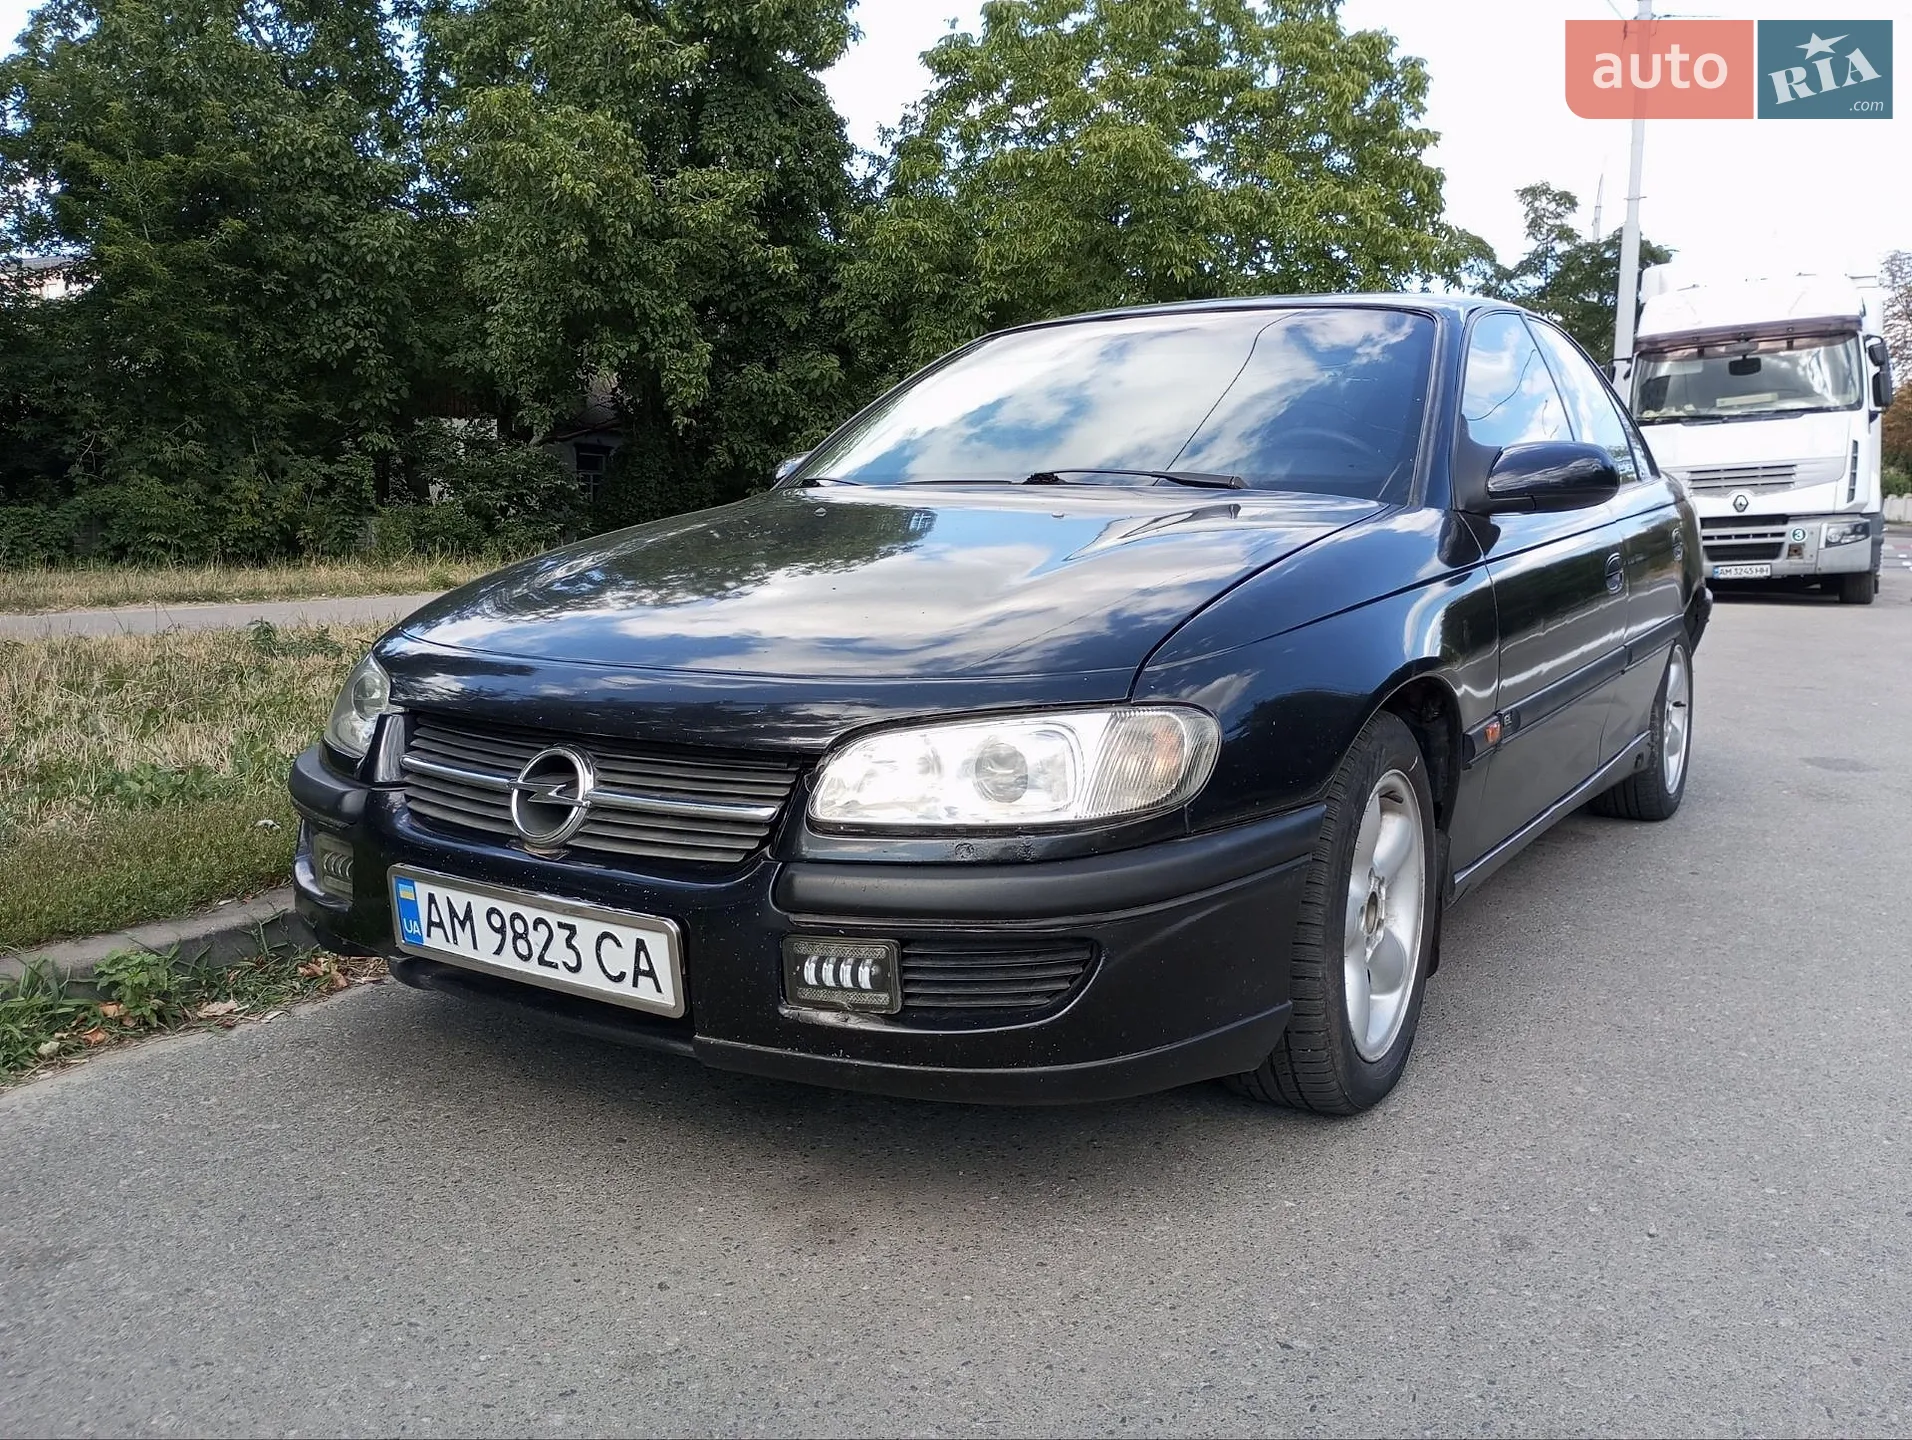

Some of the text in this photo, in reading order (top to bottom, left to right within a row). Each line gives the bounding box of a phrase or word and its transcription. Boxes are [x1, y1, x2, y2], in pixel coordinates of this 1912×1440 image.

[404, 918, 421, 936] UA
[426, 891, 663, 994] AM 9823 CA
